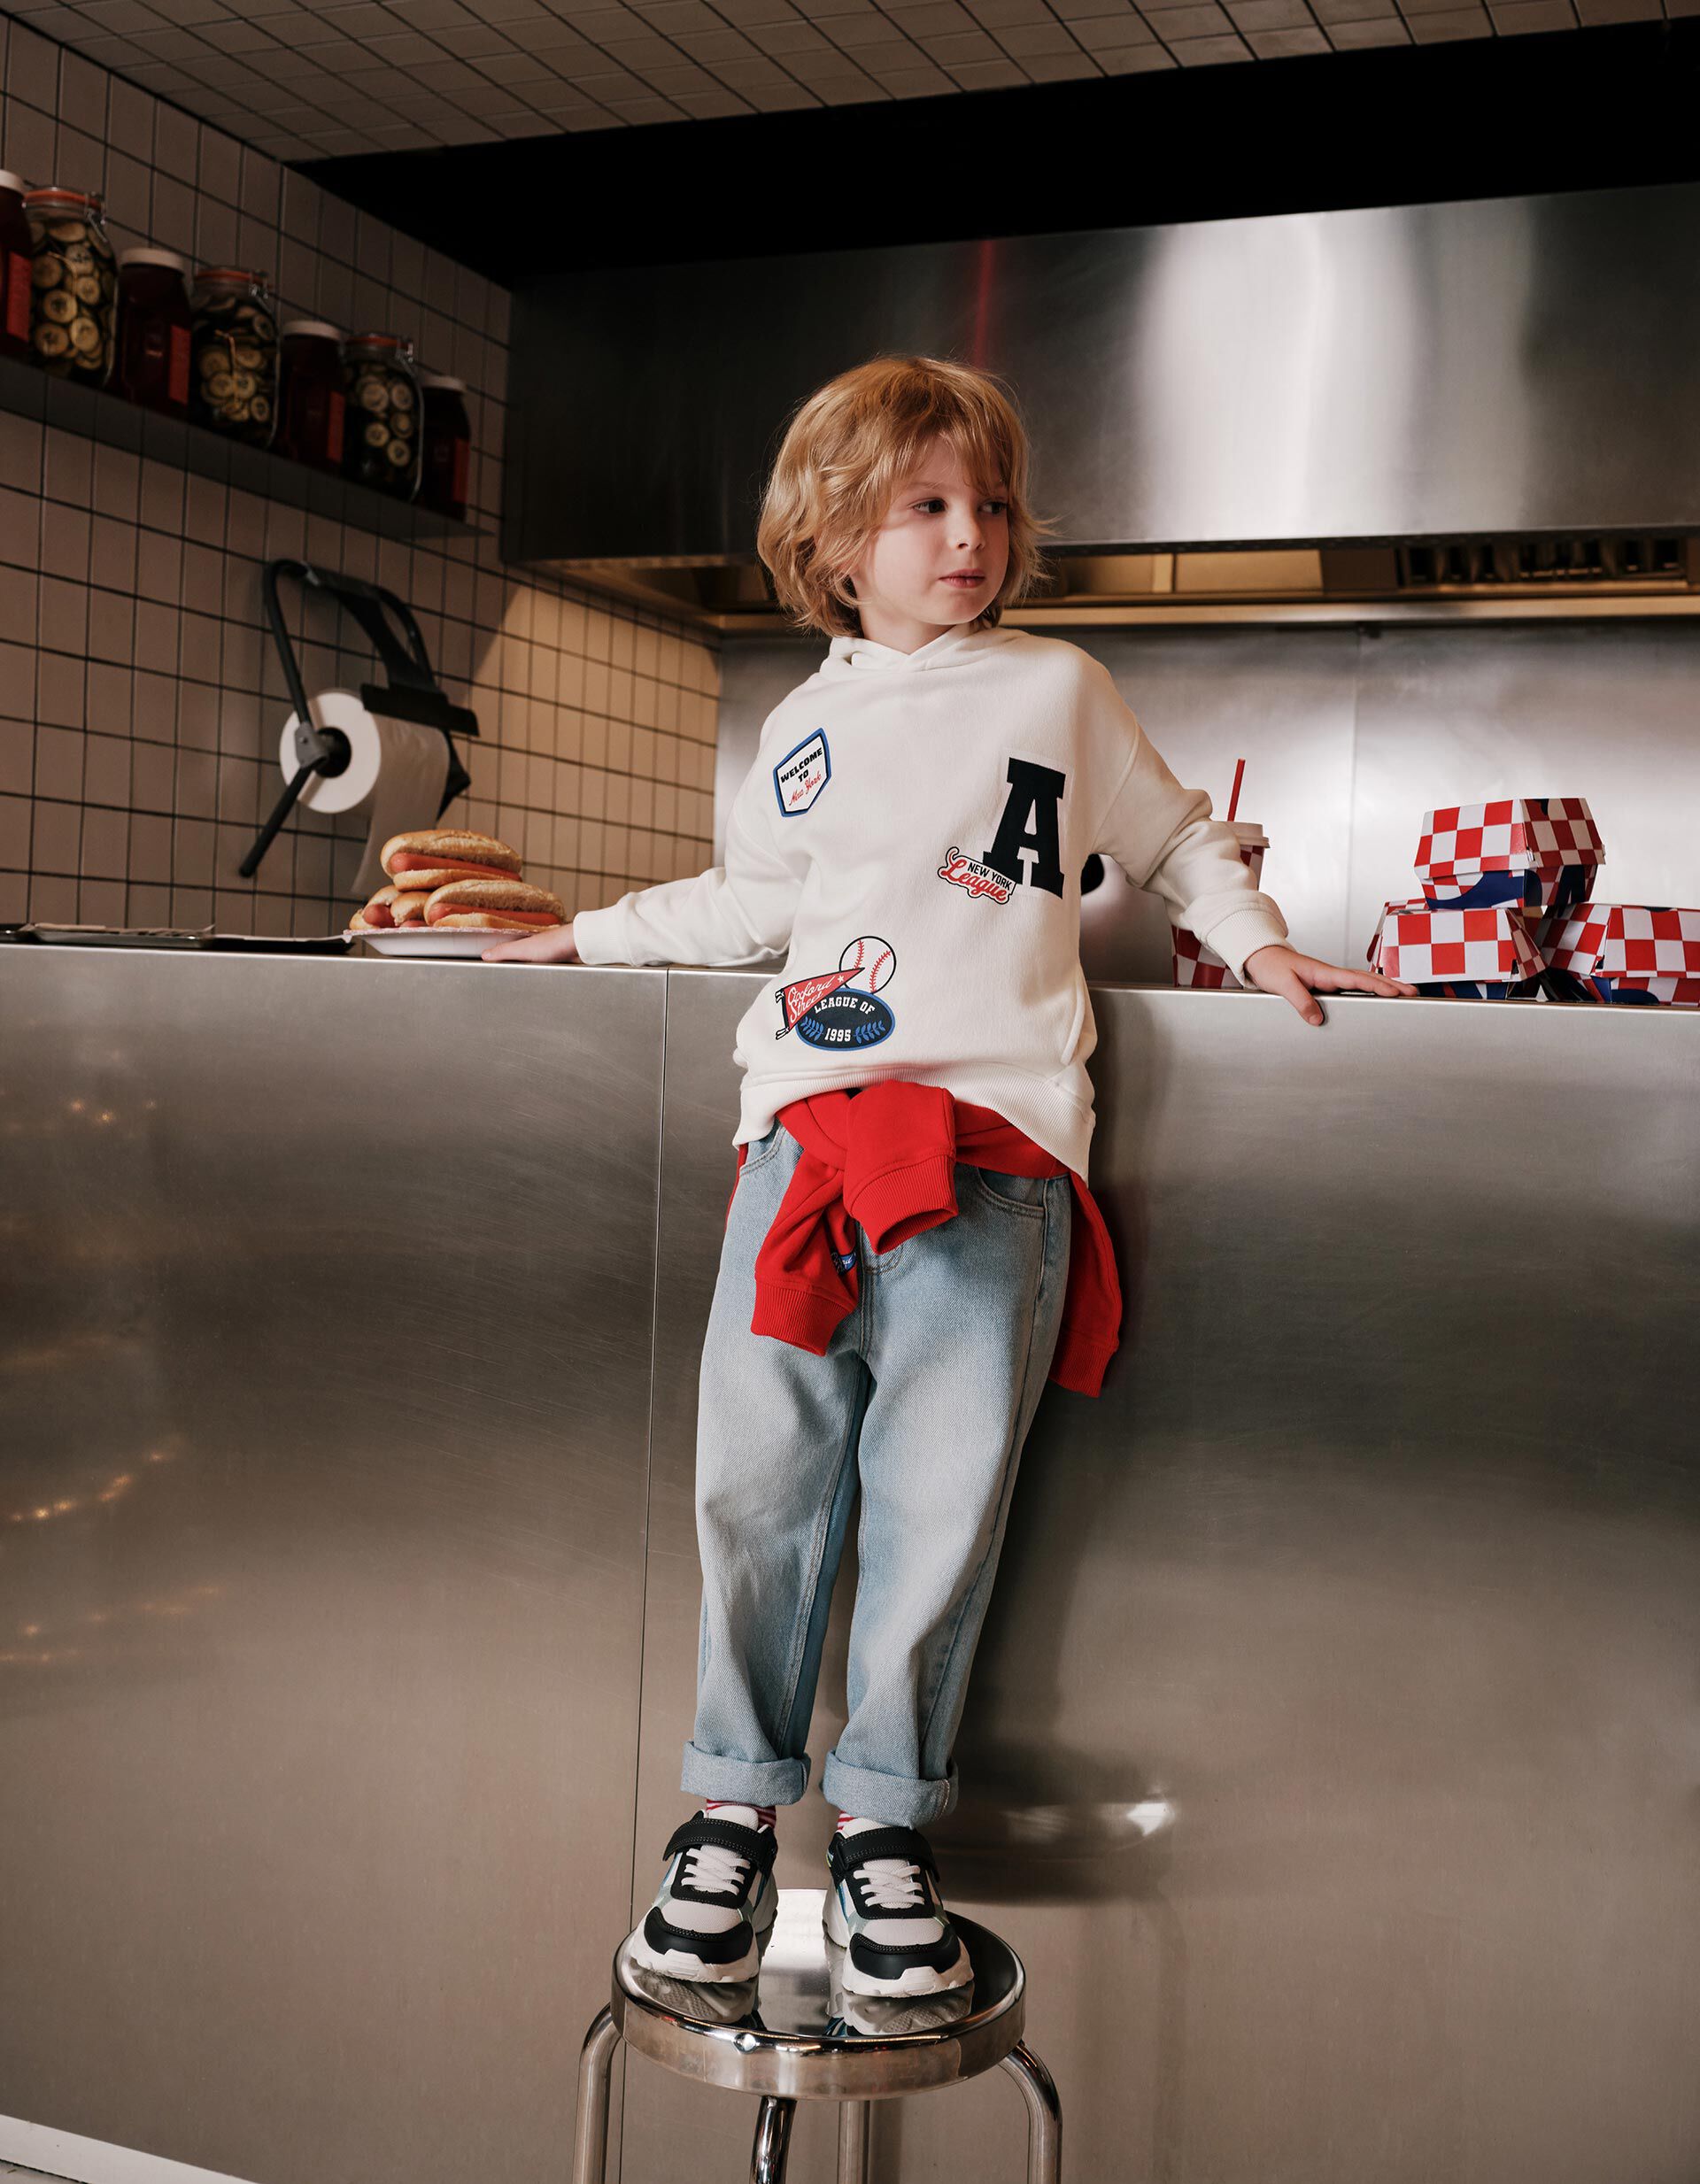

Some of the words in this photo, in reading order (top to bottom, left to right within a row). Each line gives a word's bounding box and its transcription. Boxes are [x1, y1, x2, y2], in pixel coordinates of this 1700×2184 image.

[780, 747, 823, 783] WELCOME
[798, 769, 808, 783] TO
[983, 757, 1066, 899] A
[941, 850, 1007, 901] League
[968, 862, 990, 877] NEW
[992, 872, 1012, 891] YORK
[787, 976, 836, 1006] Oxford
[814, 996, 859, 1014] LEAGUE
[860, 1001, 875, 1015] OF
[790, 993, 823, 1023] Street
[824, 1028, 852, 1042] 1995
